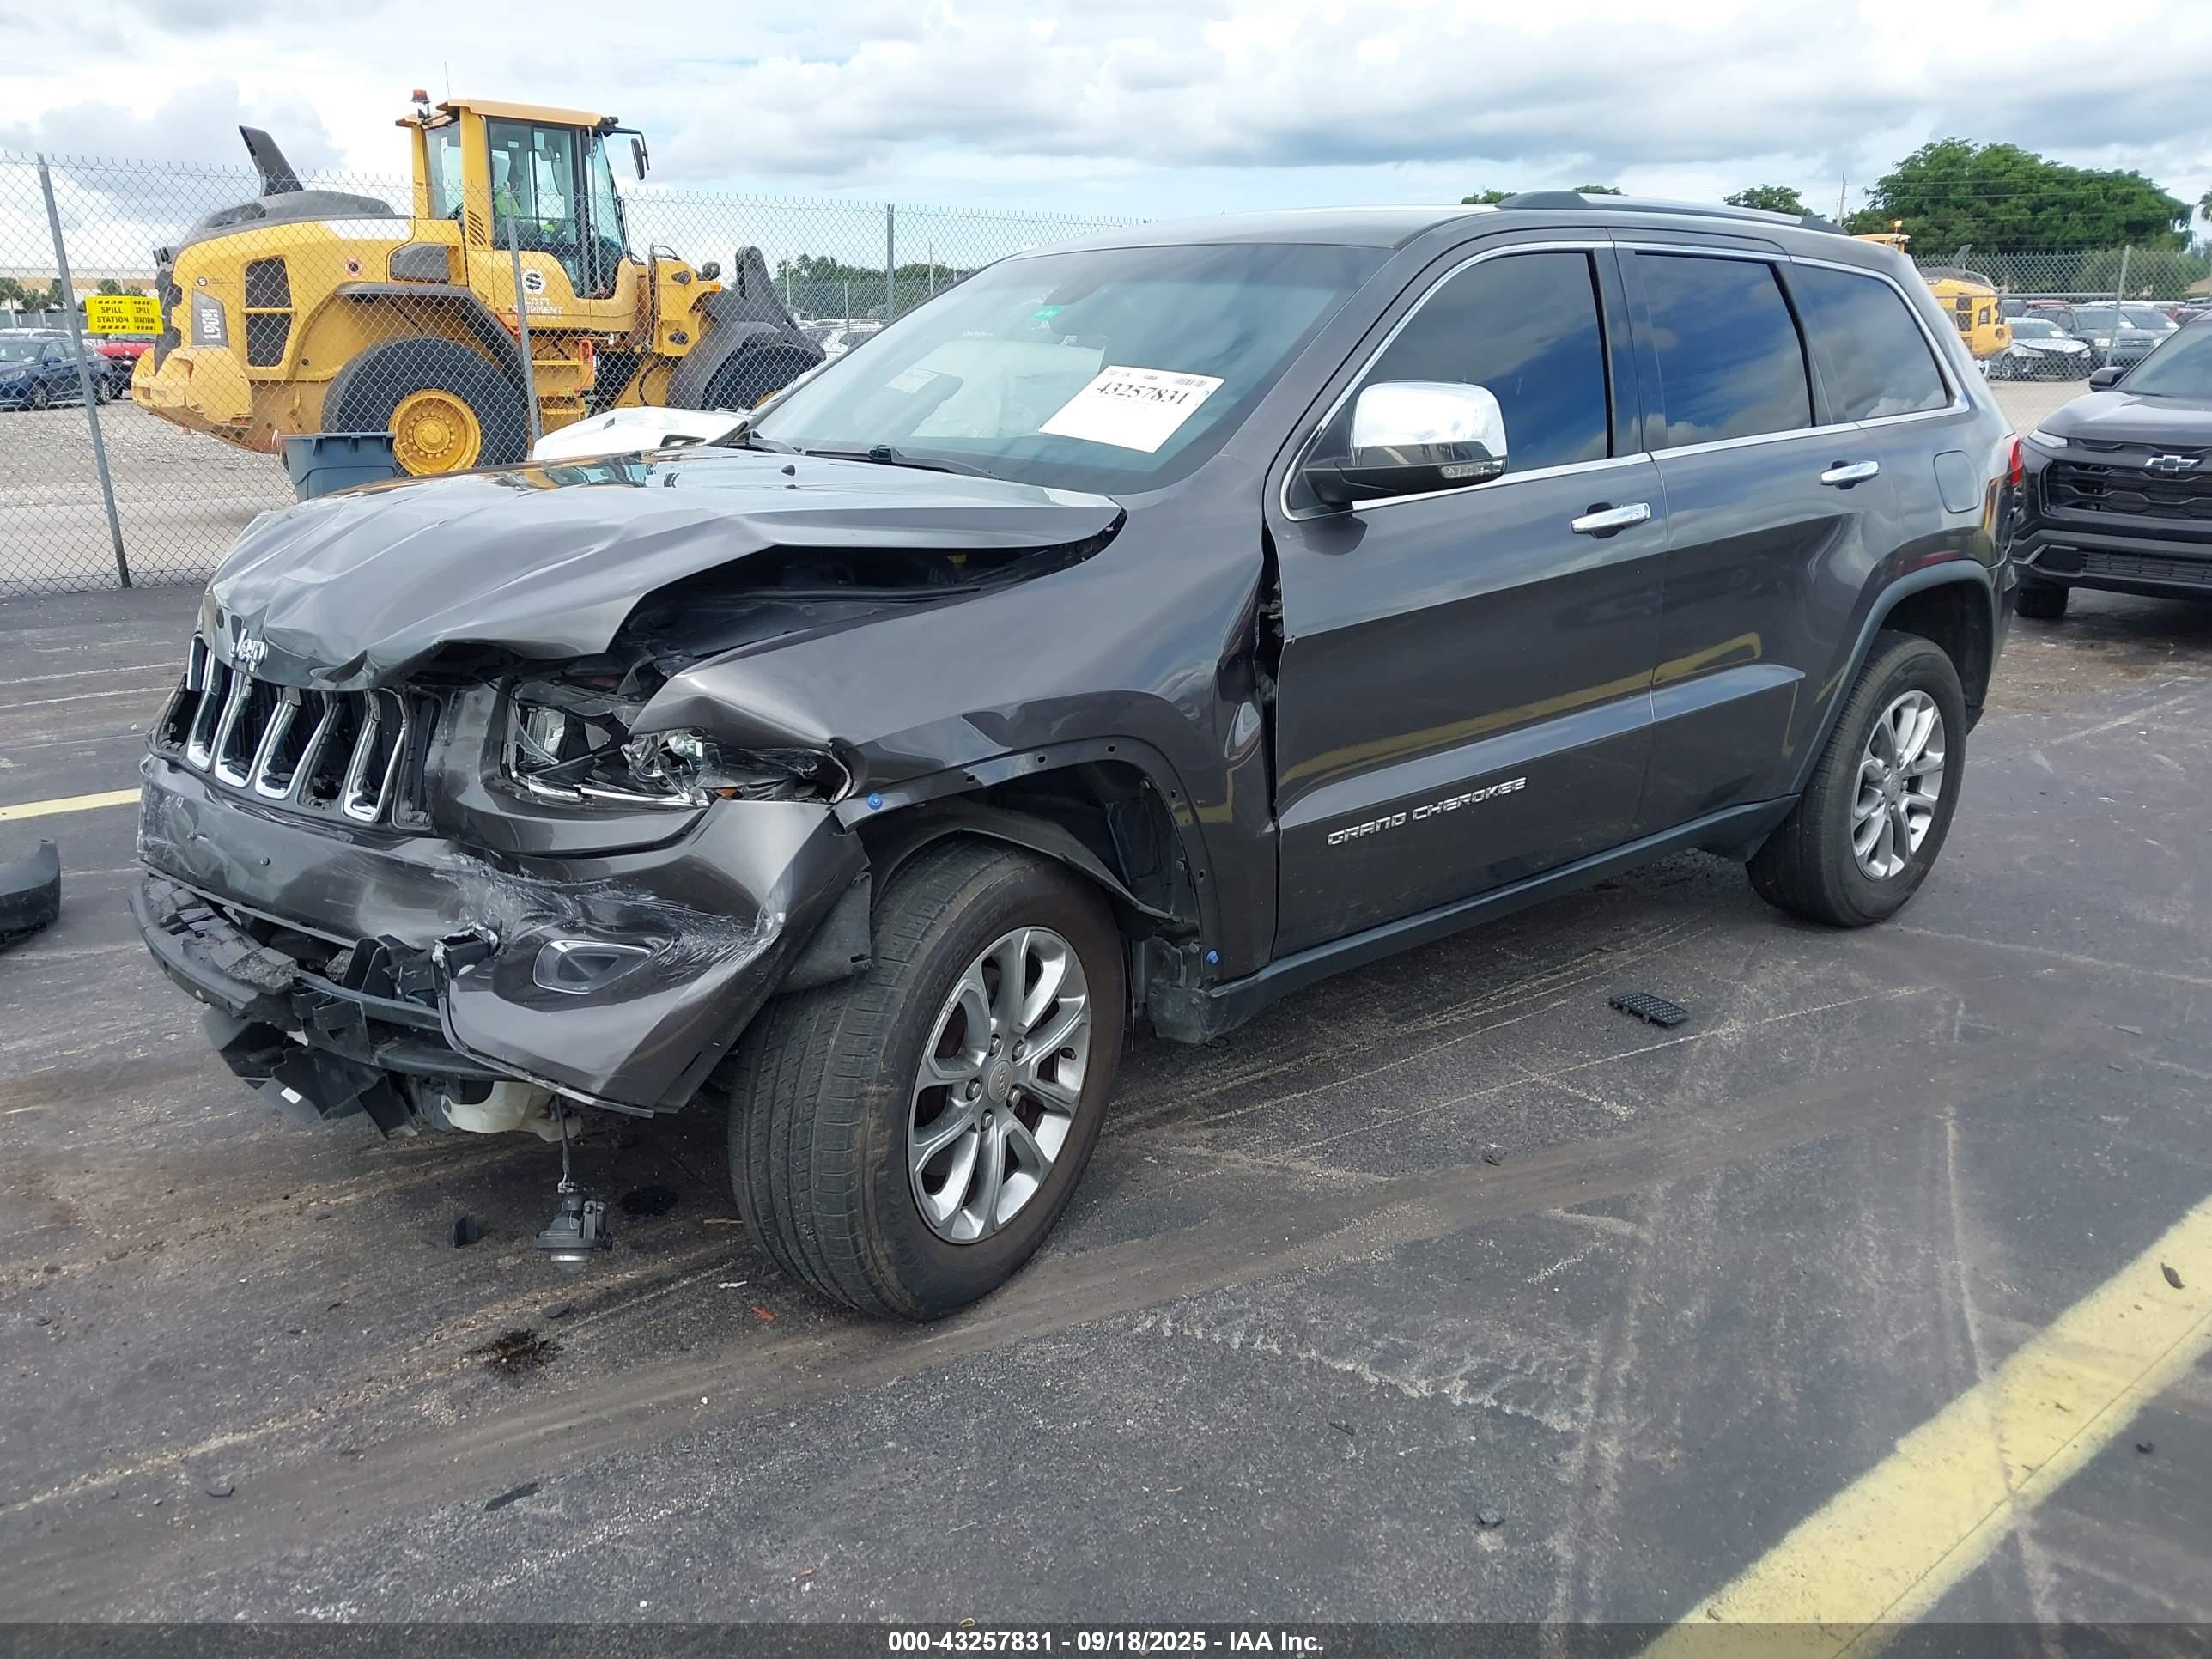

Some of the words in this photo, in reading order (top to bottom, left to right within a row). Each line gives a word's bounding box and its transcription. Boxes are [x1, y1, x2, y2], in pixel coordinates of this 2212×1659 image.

[96, 315, 130, 324] STATION
[133, 316, 155, 325] STATION
[1097, 381, 1190, 404] 43257831
[1328, 812, 1407, 846] GRAND
[1413, 776, 1527, 821] CHEROKEE
